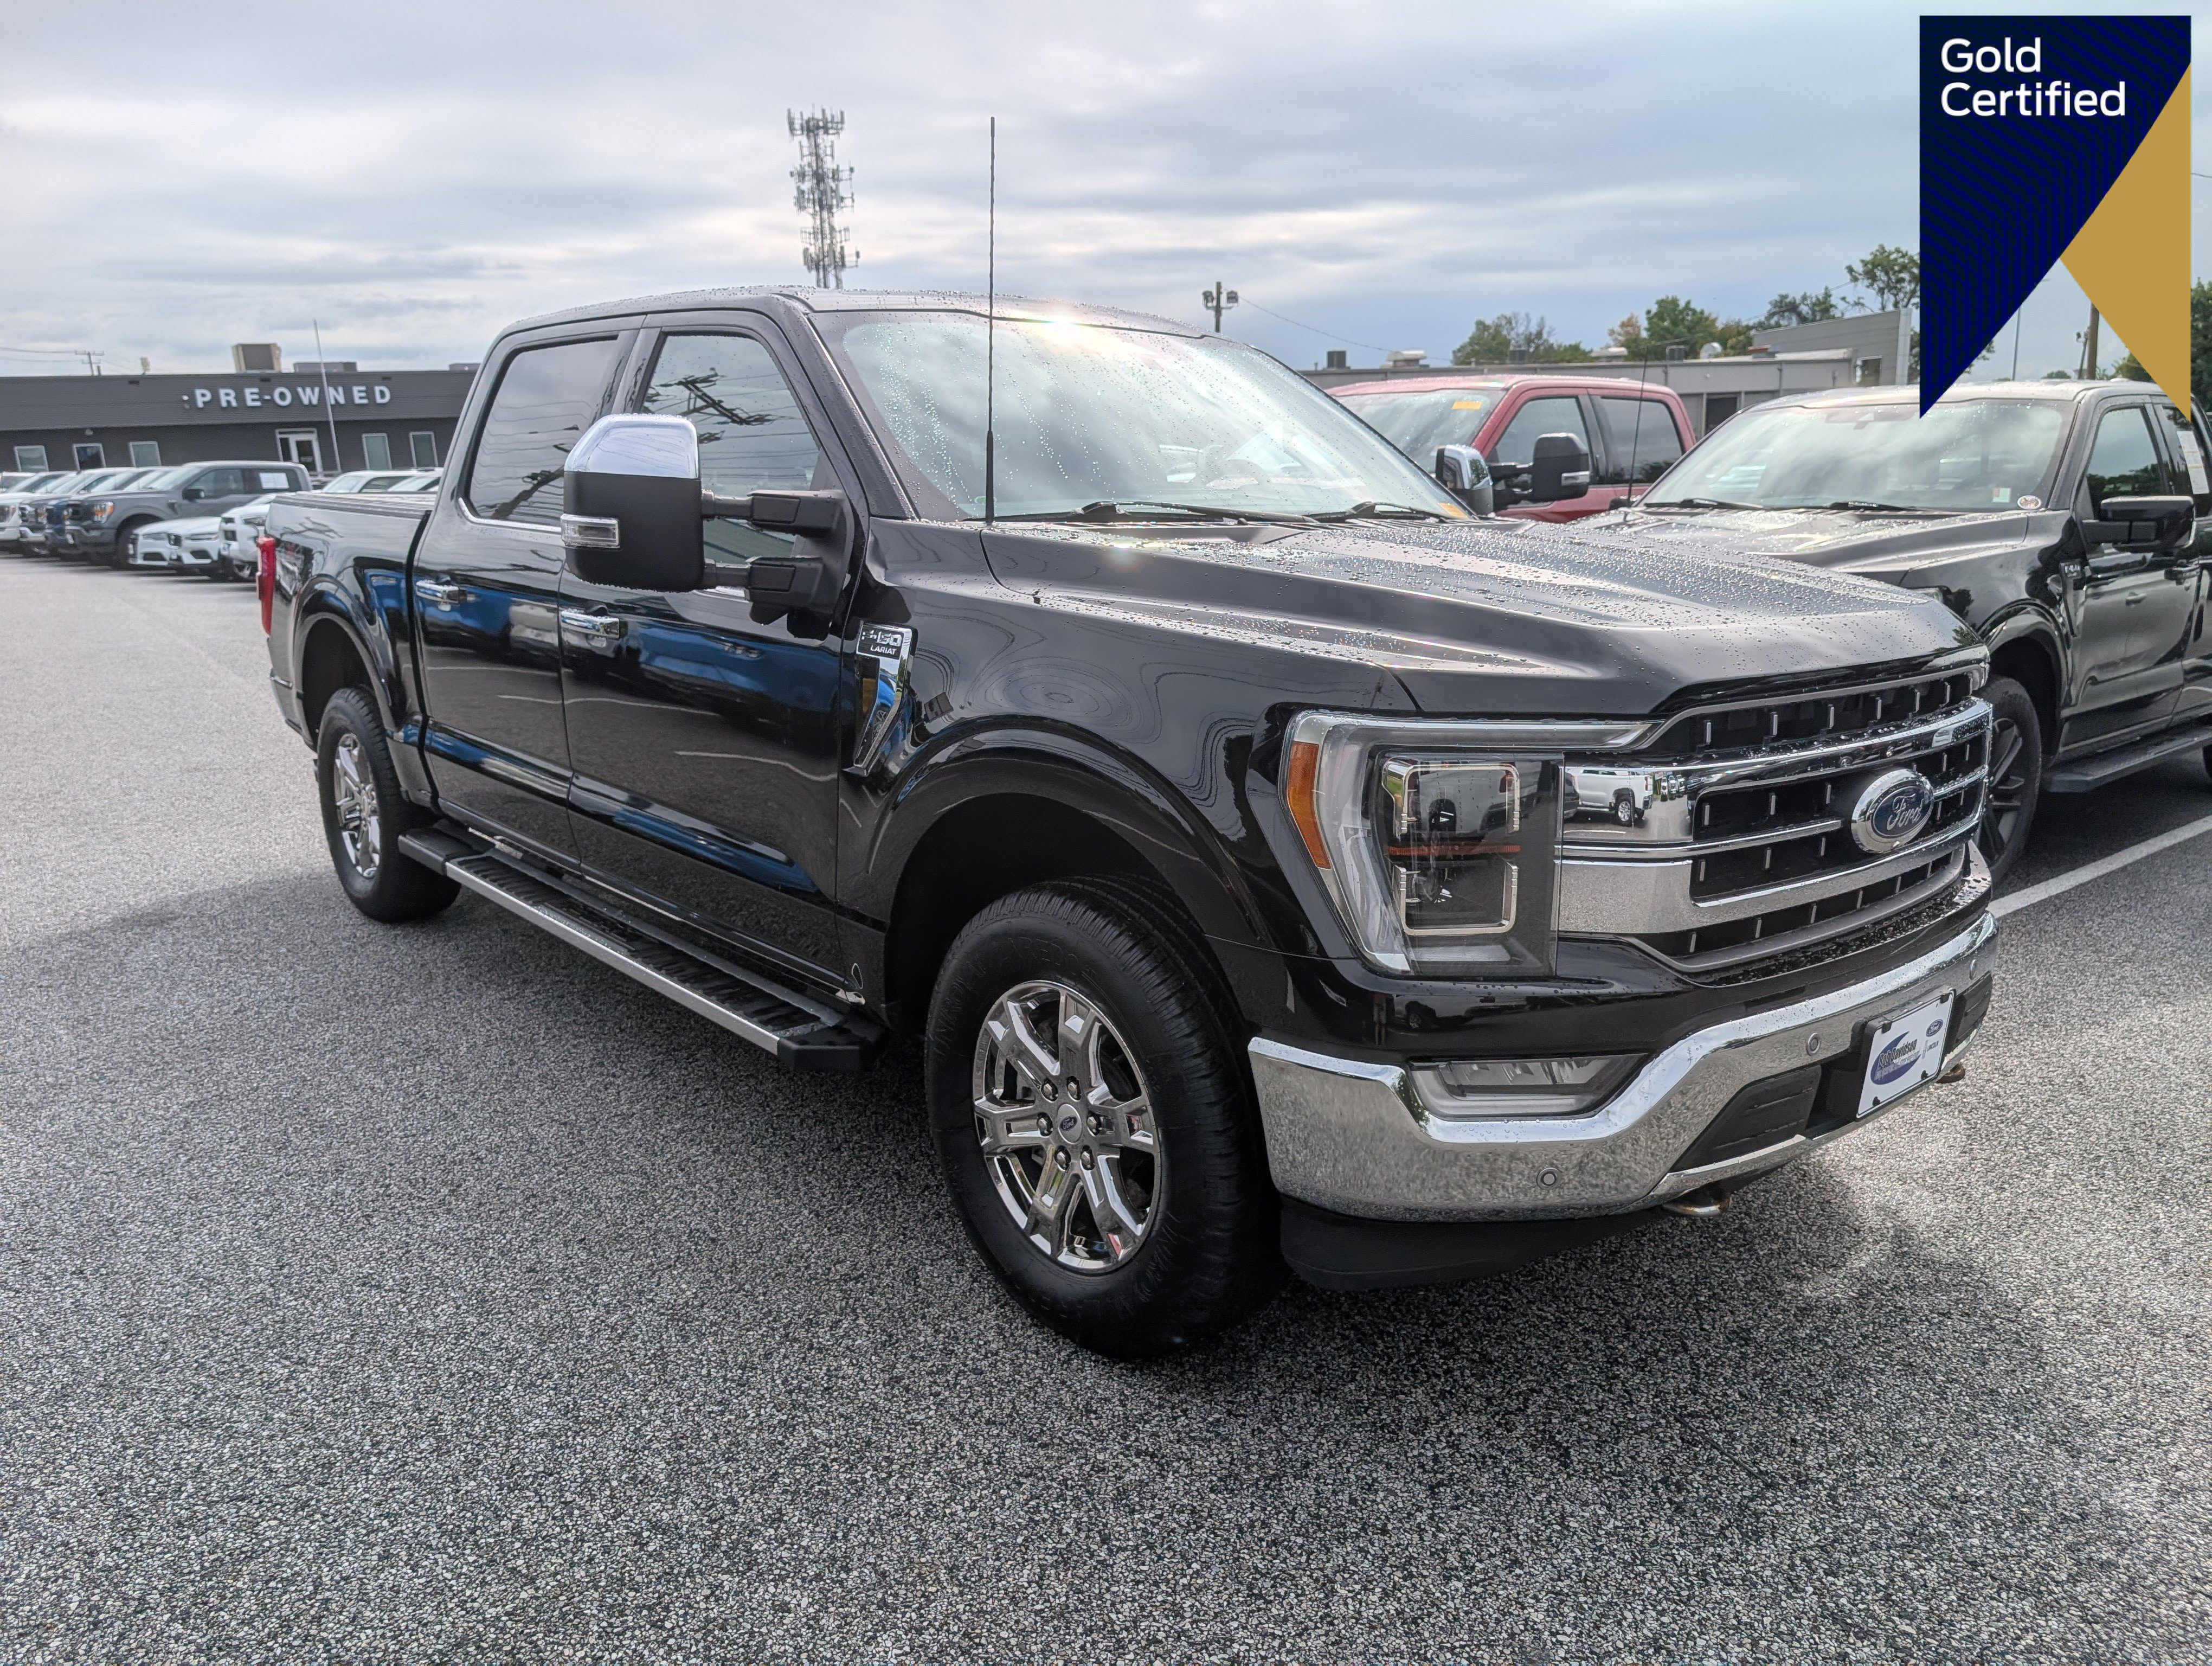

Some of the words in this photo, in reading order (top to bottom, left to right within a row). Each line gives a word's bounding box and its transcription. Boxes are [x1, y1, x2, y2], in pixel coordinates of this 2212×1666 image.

[195, 385, 391, 408] PRE-OWNED
[861, 629, 903, 647] F-150
[870, 644, 898, 655] LARIAT
[1886, 792, 1924, 831] Ford
[1877, 1049, 1891, 1069] Bob
[1890, 1038, 1918, 1062] Davidson
